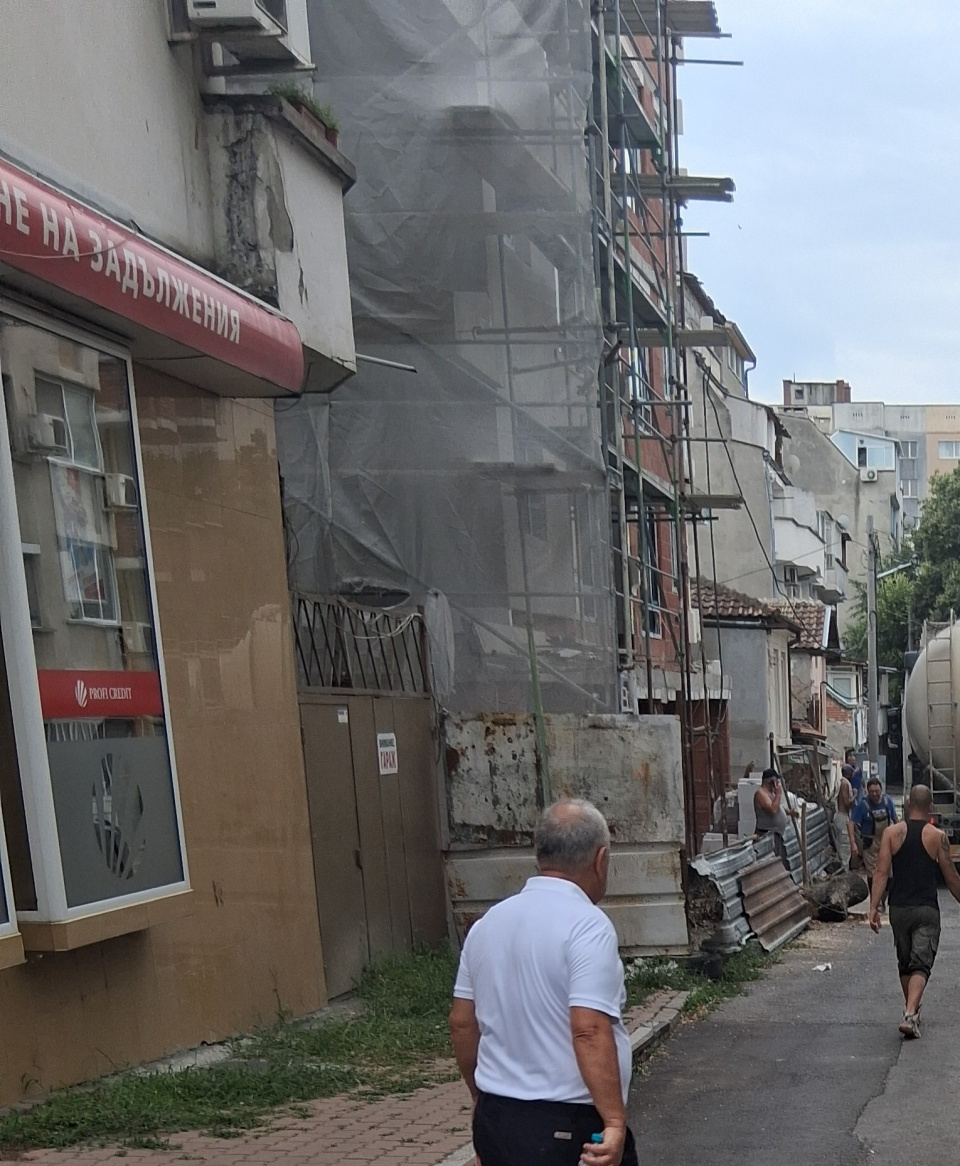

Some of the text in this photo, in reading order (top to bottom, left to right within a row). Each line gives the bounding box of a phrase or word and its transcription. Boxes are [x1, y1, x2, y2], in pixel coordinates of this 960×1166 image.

[40, 202, 80, 262] НА
[88, 229, 240, 344] ЗАДЪЛЖЕНИЯ
[89, 687, 132, 700] PROFI CREDIT
